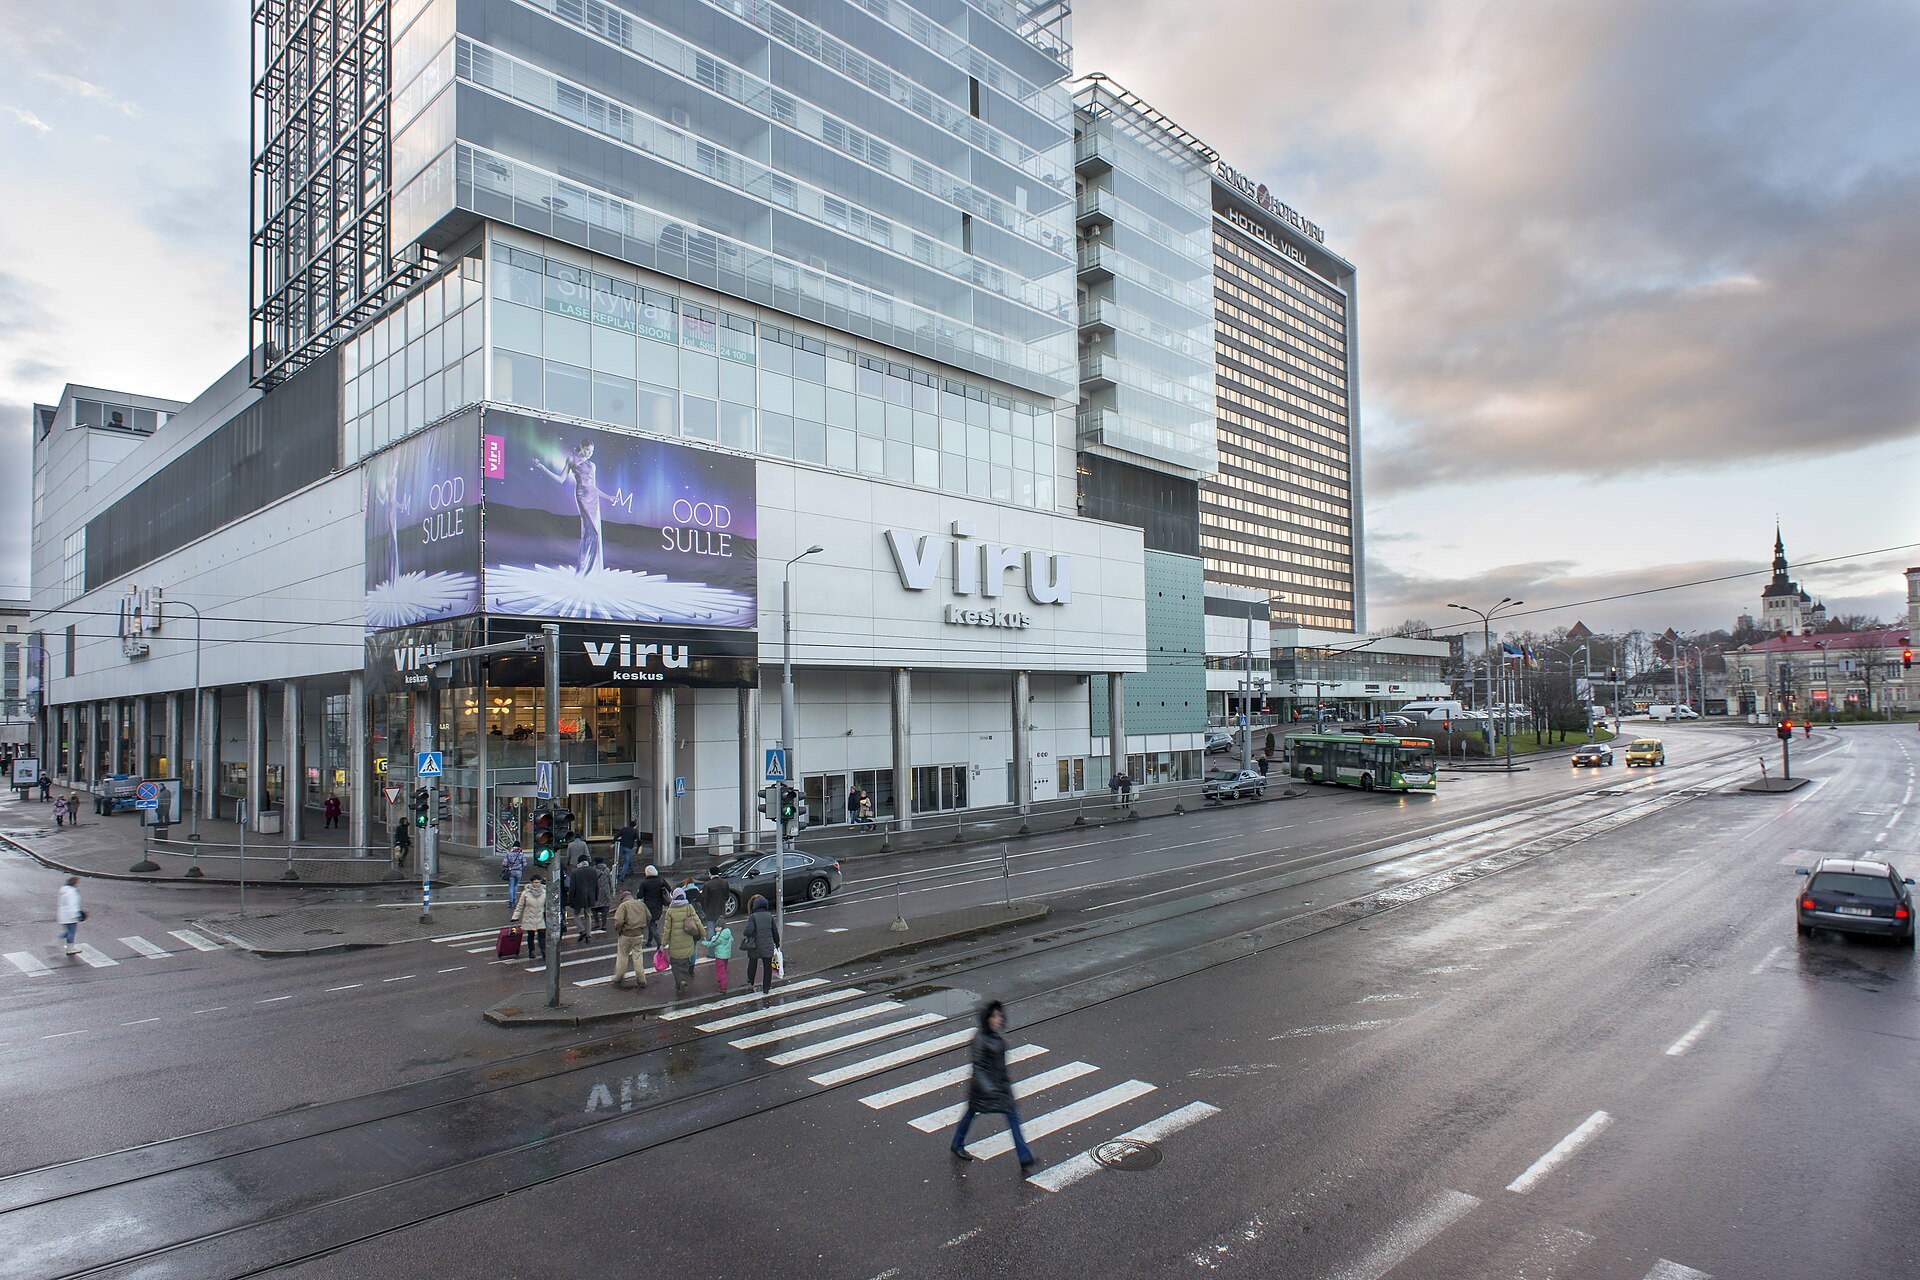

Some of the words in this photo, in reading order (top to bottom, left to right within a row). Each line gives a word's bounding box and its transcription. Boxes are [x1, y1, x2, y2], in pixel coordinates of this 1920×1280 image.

[1218, 161, 1257, 199] SOKOS
[1300, 216, 1324, 243] VIRU
[1229, 208, 1279, 248] HOTELL
[1281, 240, 1307, 265] VIRU
[721, 347, 730, 356] 24
[732, 351, 747, 361] 100
[488, 441, 498, 472] viru
[429, 476, 465, 511] OOD
[422, 508, 464, 544] SULLE
[672, 499, 732, 529] OOD
[661, 526, 733, 558] SULLE
[884, 520, 1072, 605] viru
[945, 603, 1033, 629] keskus
[583, 635, 689, 669] viru
[405, 674, 428, 684] keskus
[613, 670, 664, 681] keskus
